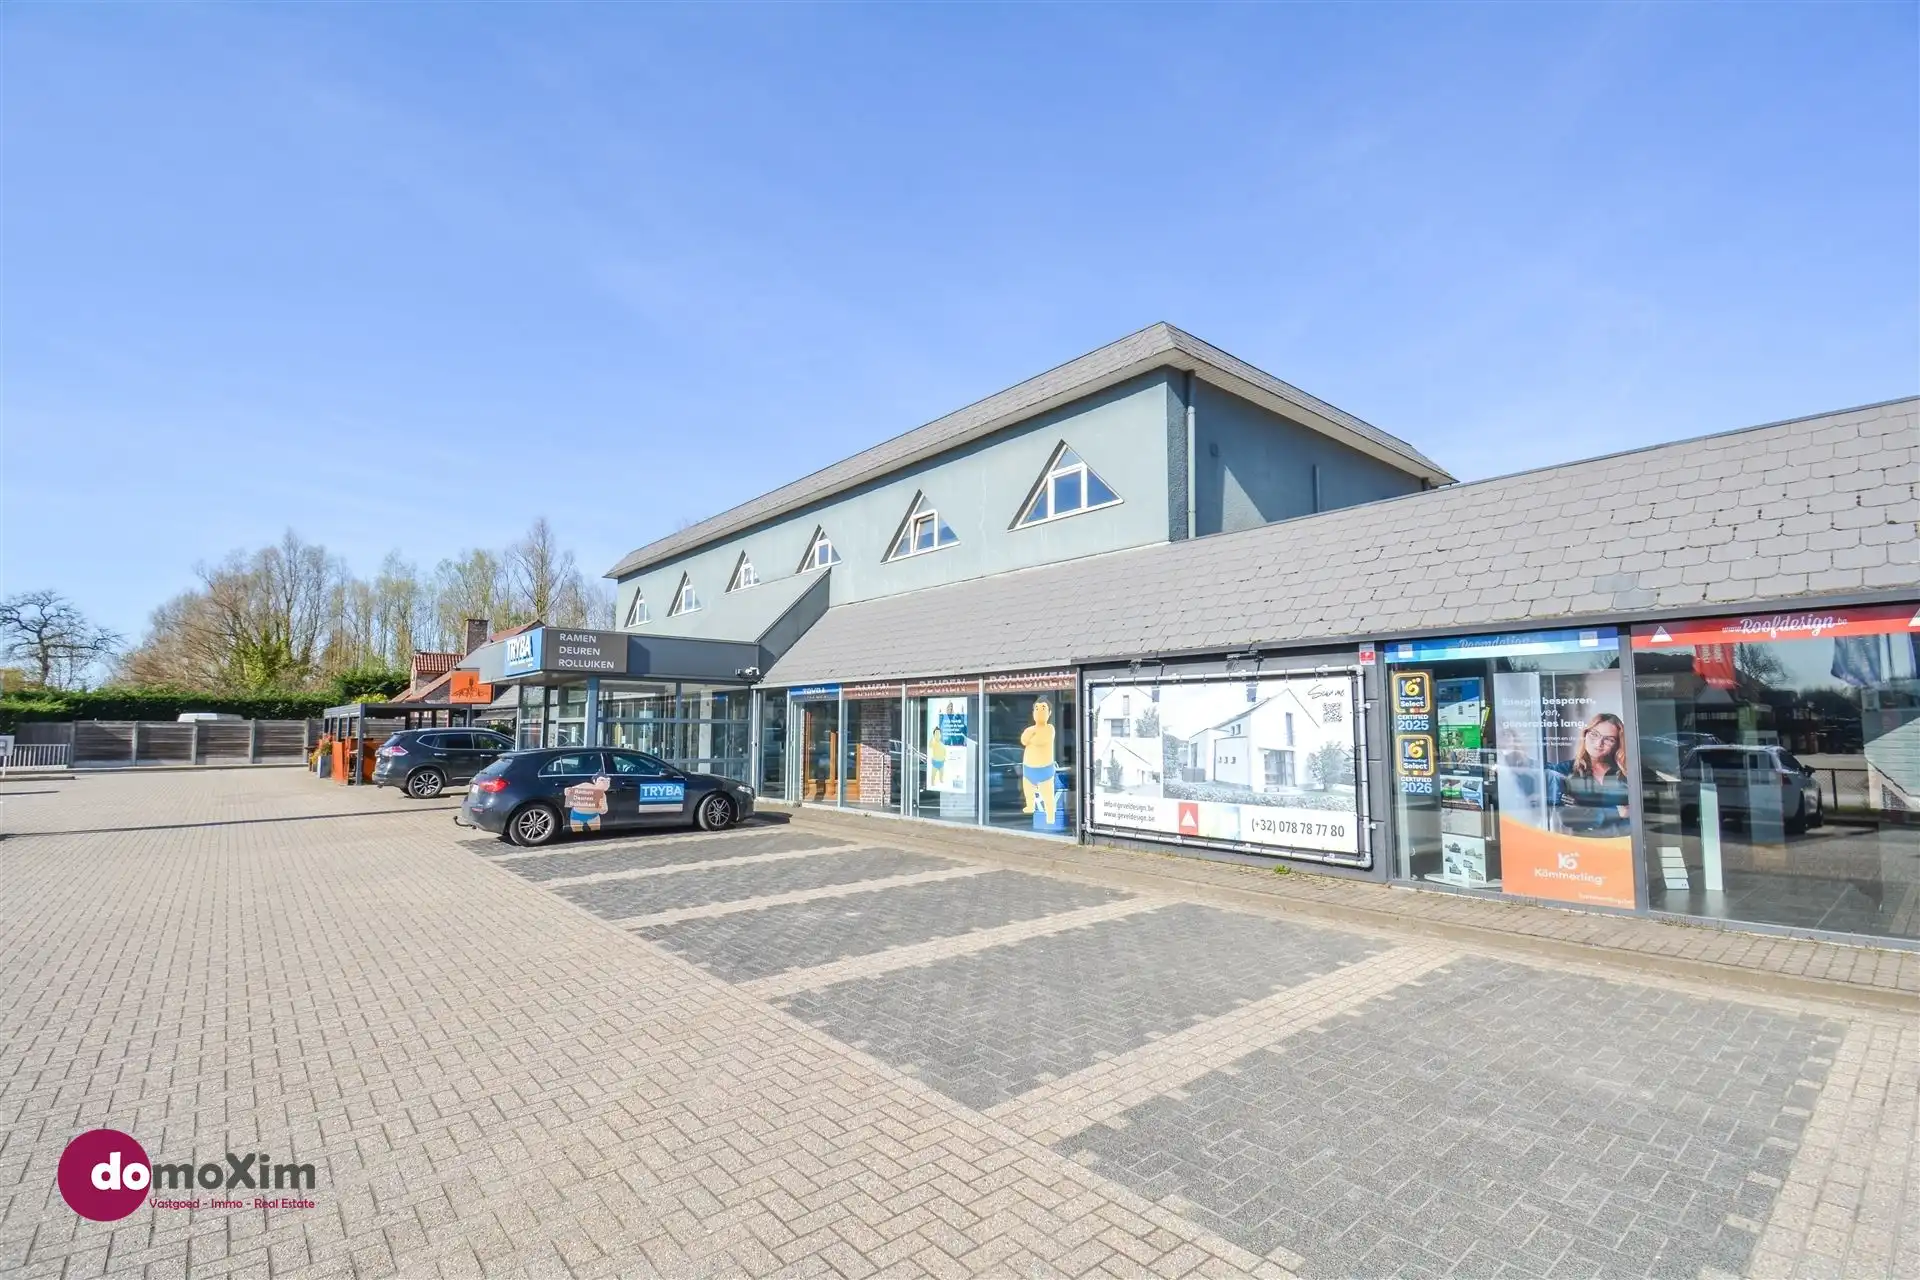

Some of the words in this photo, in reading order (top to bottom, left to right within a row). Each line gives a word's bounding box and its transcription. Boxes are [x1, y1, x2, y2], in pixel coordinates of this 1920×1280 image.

[559, 633, 597, 644] RAMEN
[506, 636, 534, 662] TRYBA
[559, 646, 601, 656] DEUREN
[558, 658, 615, 669] ROLLUIKEN
[1398, 720, 1430, 731] 2025
[1560, 719, 1588, 729] lang.
[1403, 762, 1428, 770] Select
[642, 785, 683, 797] TRYBA
[1401, 782, 1433, 794] 2026
[1251, 817, 1276, 834] (+32)
[1278, 820, 1298, 834] 078
[1299, 822, 1313, 835] 78
[1315, 823, 1328, 837] 77
[1330, 824, 1345, 838] 80
